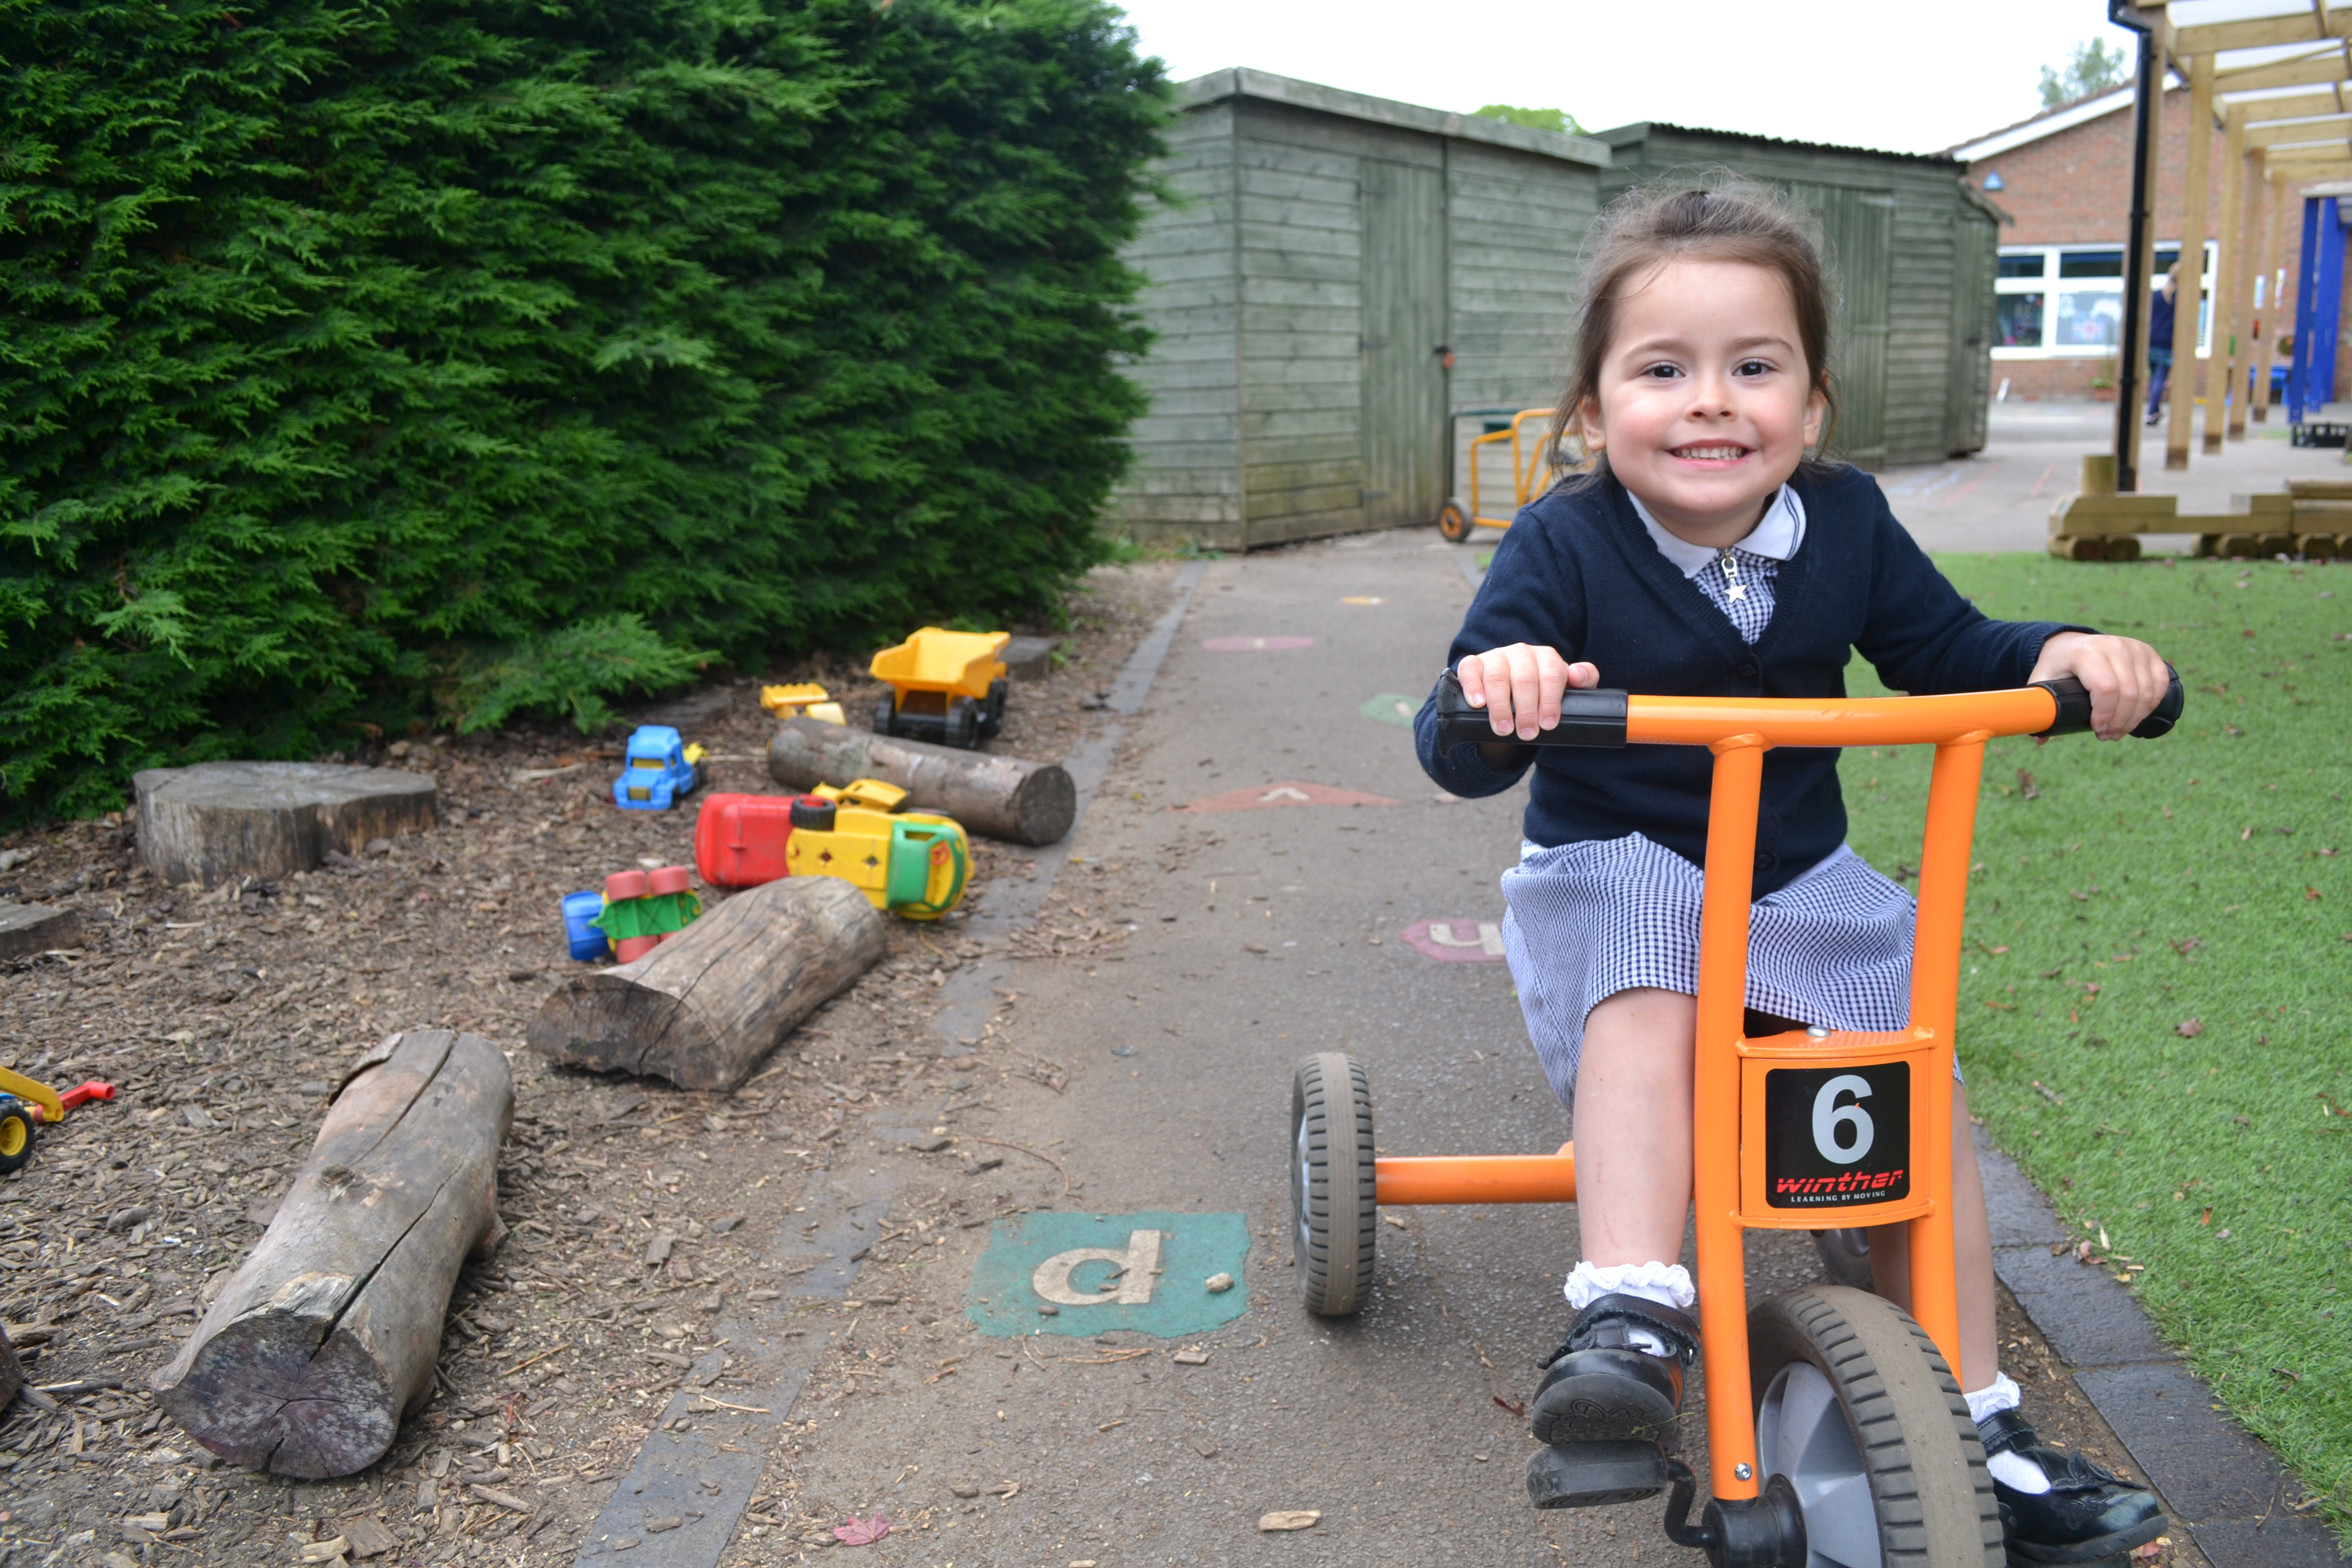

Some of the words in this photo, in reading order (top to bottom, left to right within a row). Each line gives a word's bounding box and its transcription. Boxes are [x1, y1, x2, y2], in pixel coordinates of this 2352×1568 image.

[1812, 1074, 1874, 1164] 6
[1776, 1170, 1904, 1193] winther
[1791, 1194, 1837, 1203] LEARNING
[1853, 1190, 1885, 1200] MOVING
